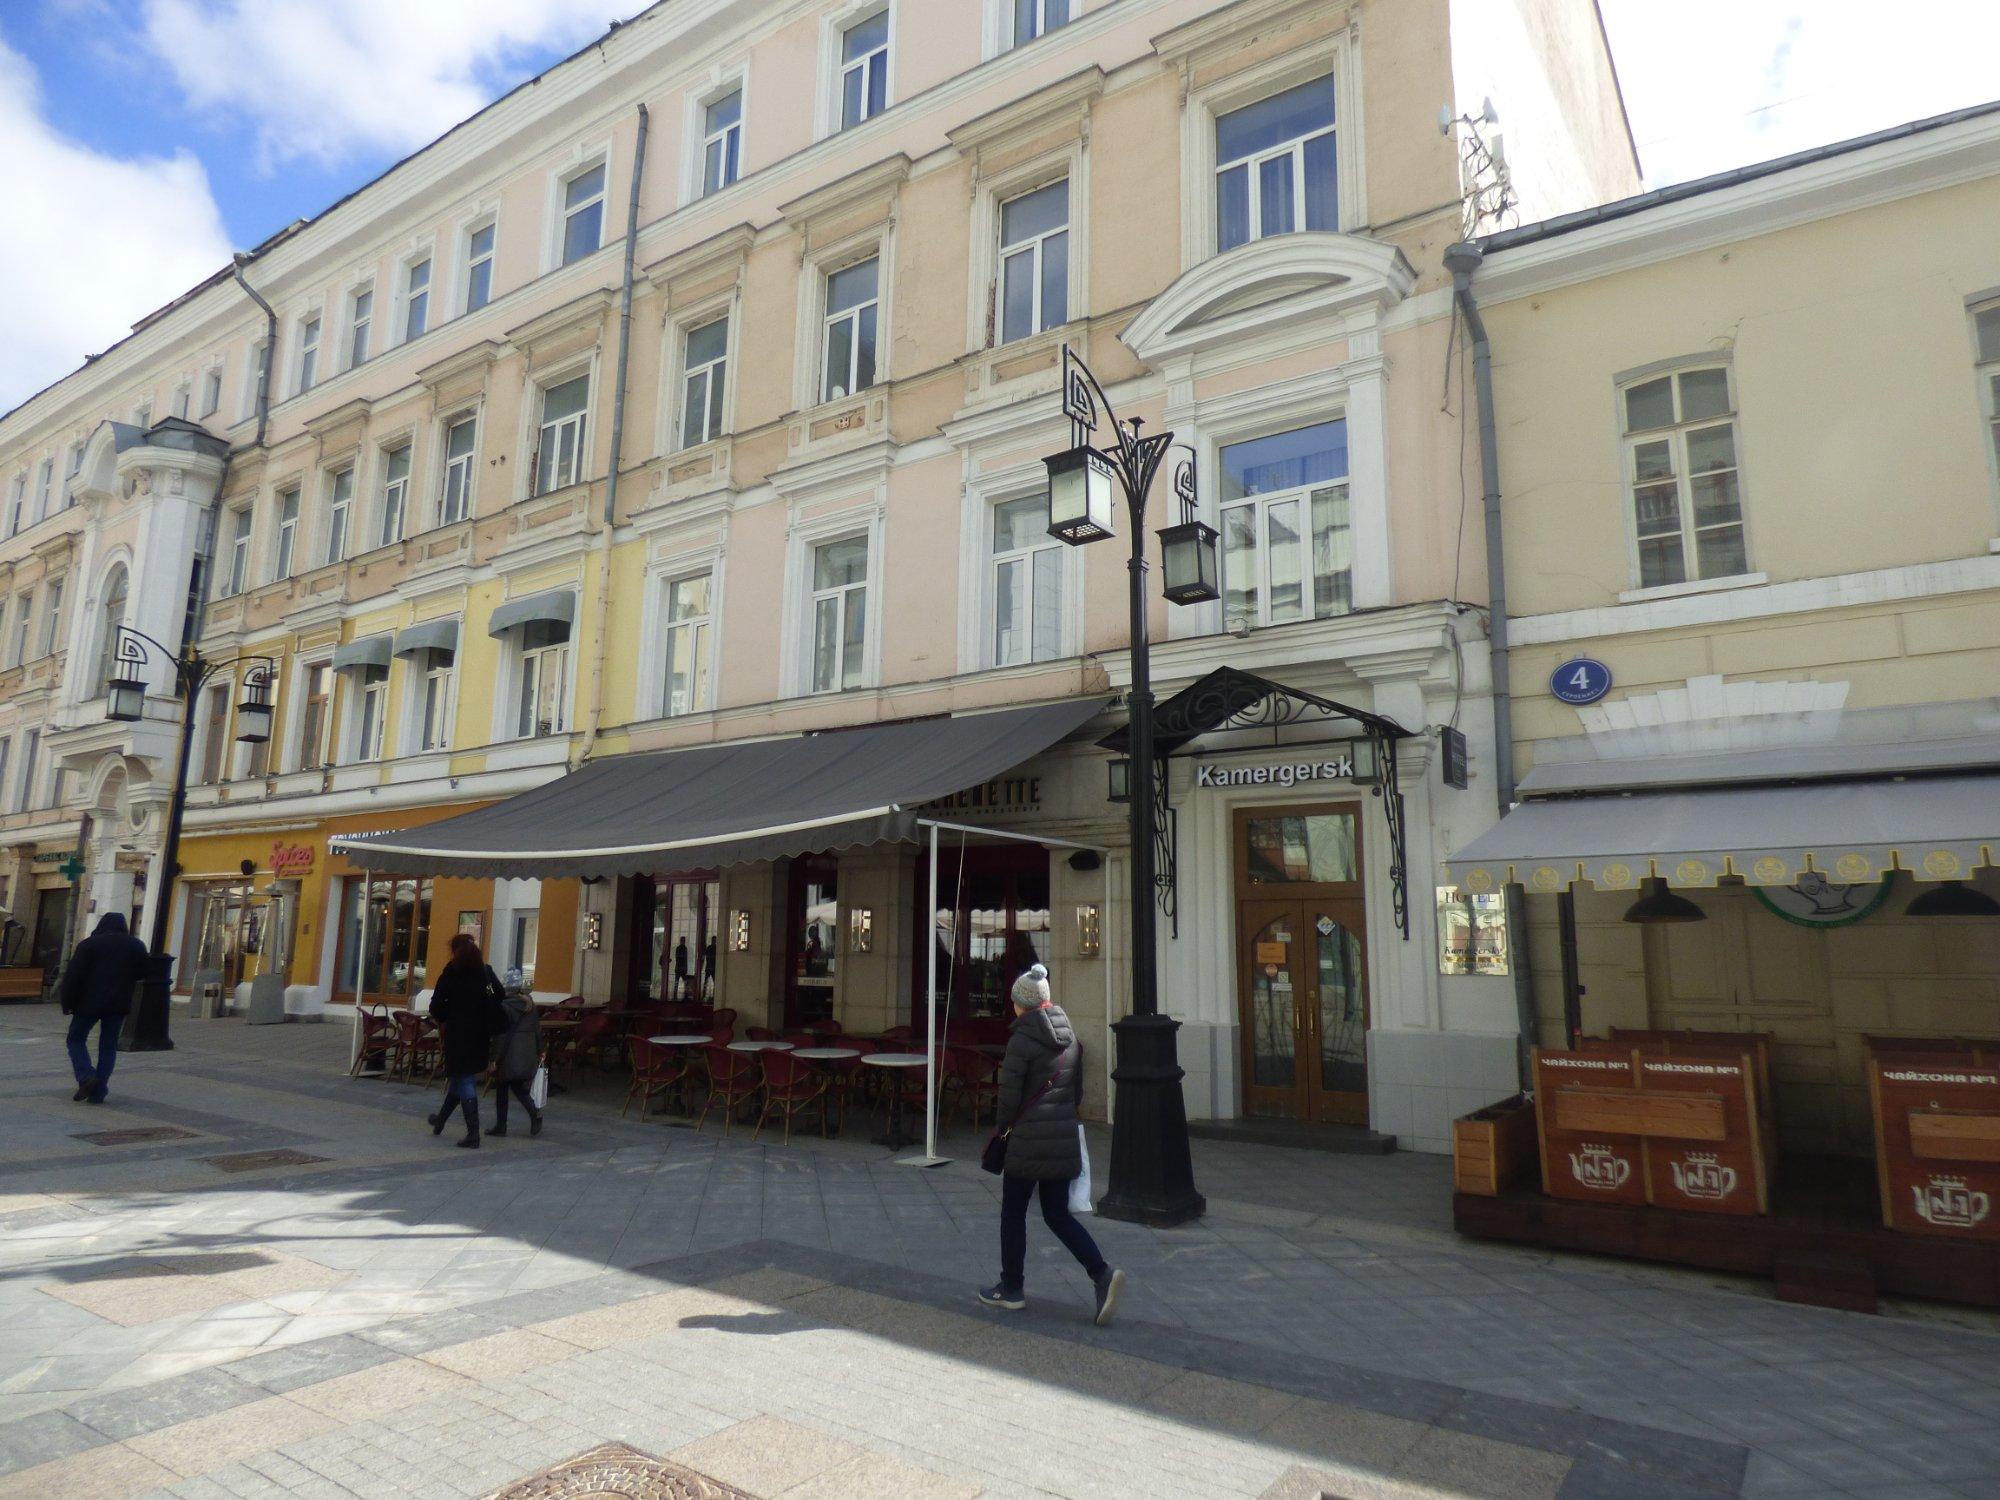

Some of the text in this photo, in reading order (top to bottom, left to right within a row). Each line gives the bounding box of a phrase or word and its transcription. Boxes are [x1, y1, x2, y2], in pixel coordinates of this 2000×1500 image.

[1570, 666, 1590, 690] 4
[1198, 755, 1353, 787] Kamergersk
[1446, 892, 1495, 903] HOEL
[1541, 1058, 1606, 1070] ЧАЙХОНА
[1644, 1062, 1714, 1074] ЧАЙХОНА
[1883, 1071, 1967, 1083] ЧАЙХОНА
